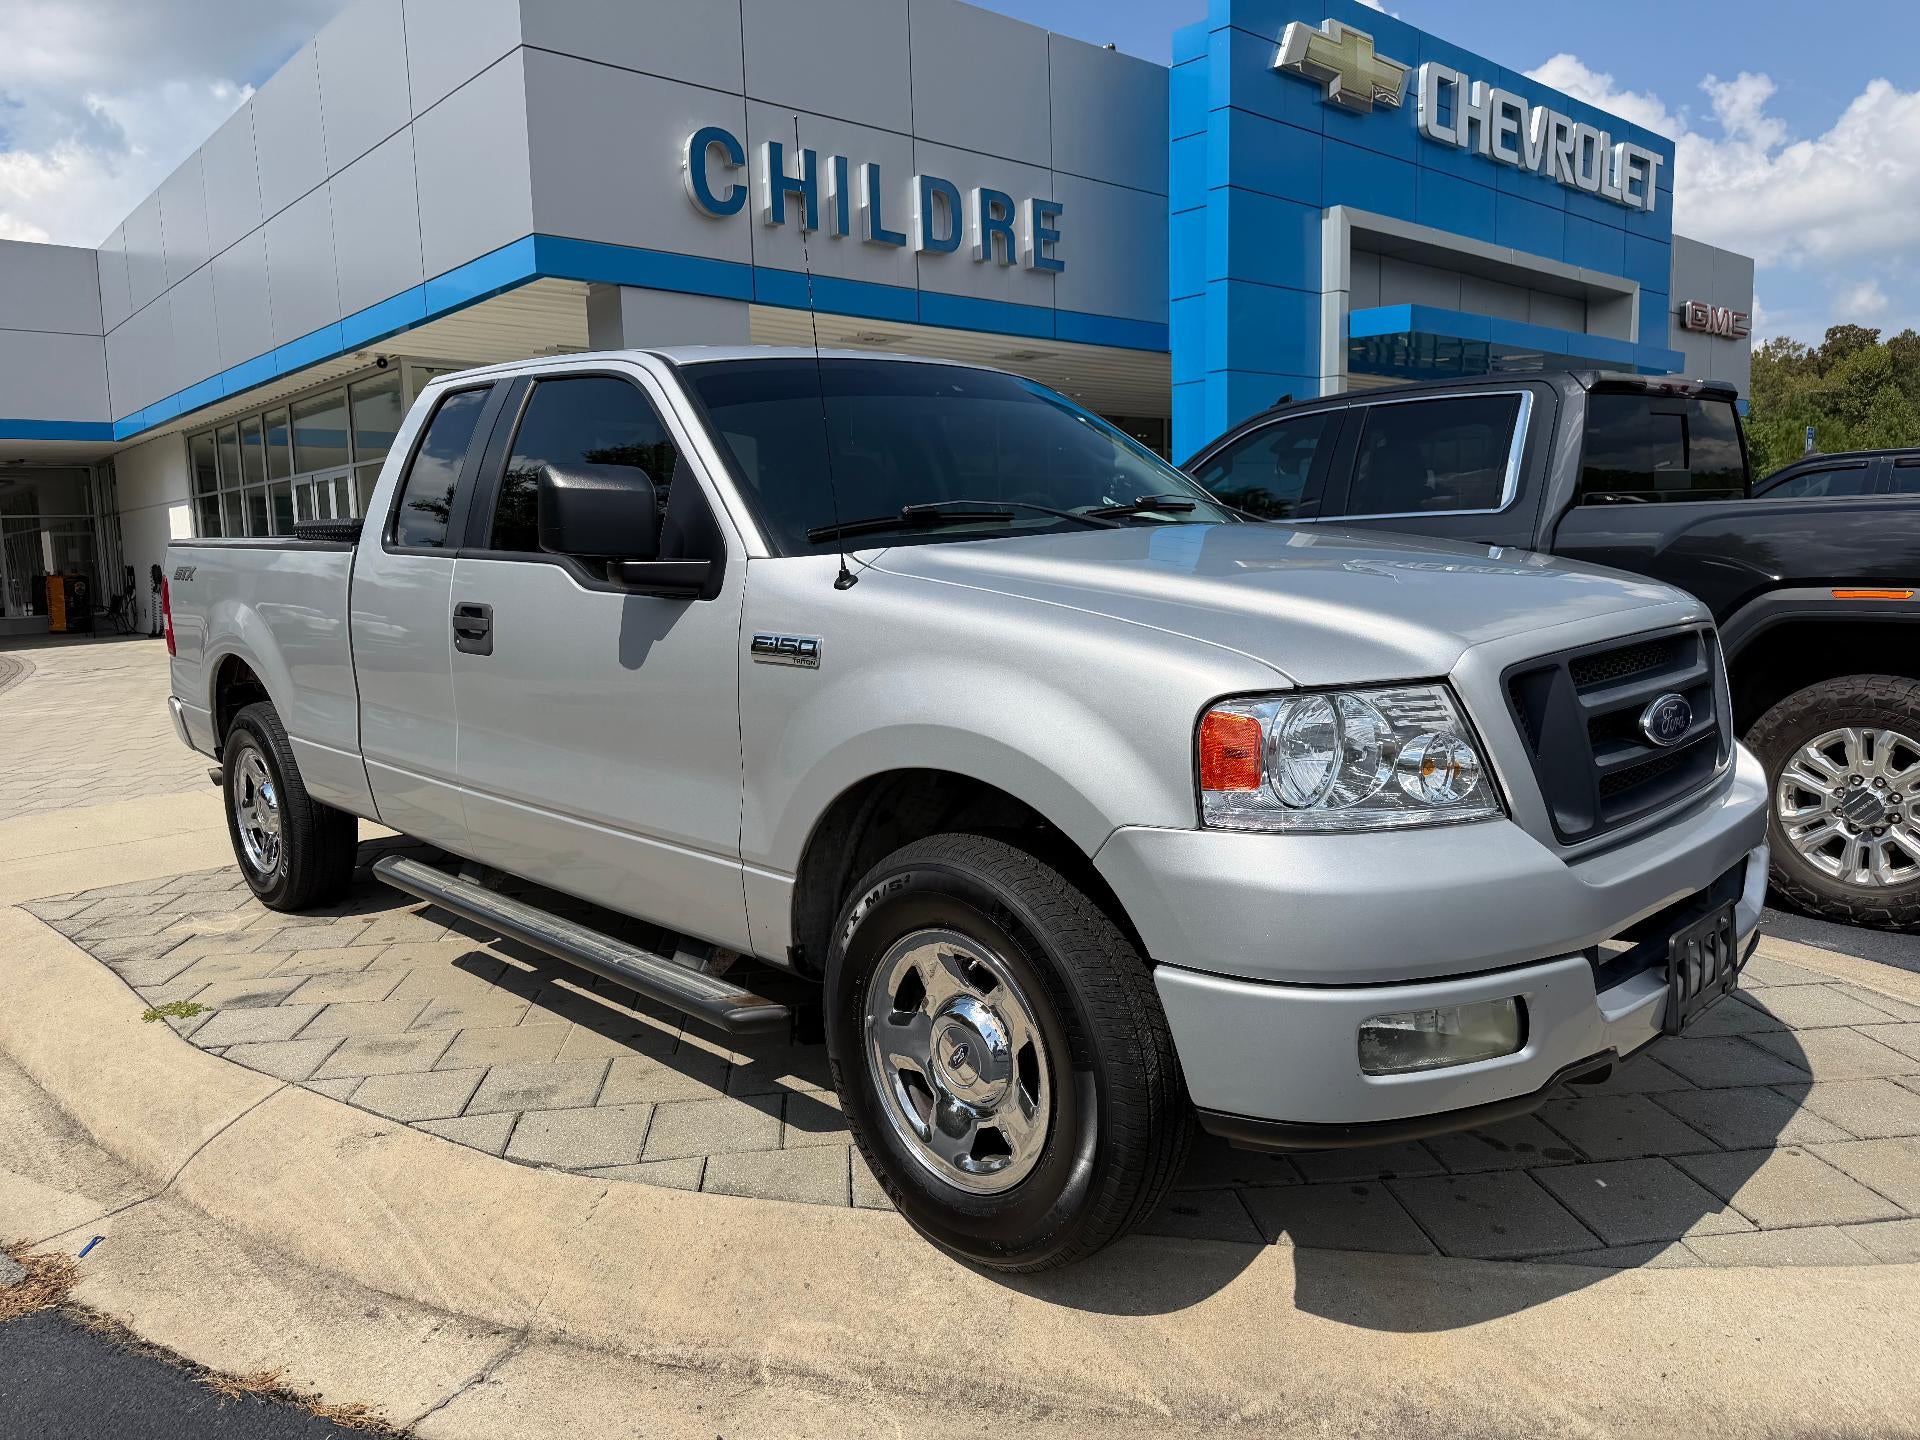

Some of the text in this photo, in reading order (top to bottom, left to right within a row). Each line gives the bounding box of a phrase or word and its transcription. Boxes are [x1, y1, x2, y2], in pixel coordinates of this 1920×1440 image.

[1418, 62, 1663, 212] CHEVROLET
[683, 126, 1065, 273] CHILDRE
[1684, 300, 1748, 338] GMC
[1661, 704, 1686, 735] Ford
